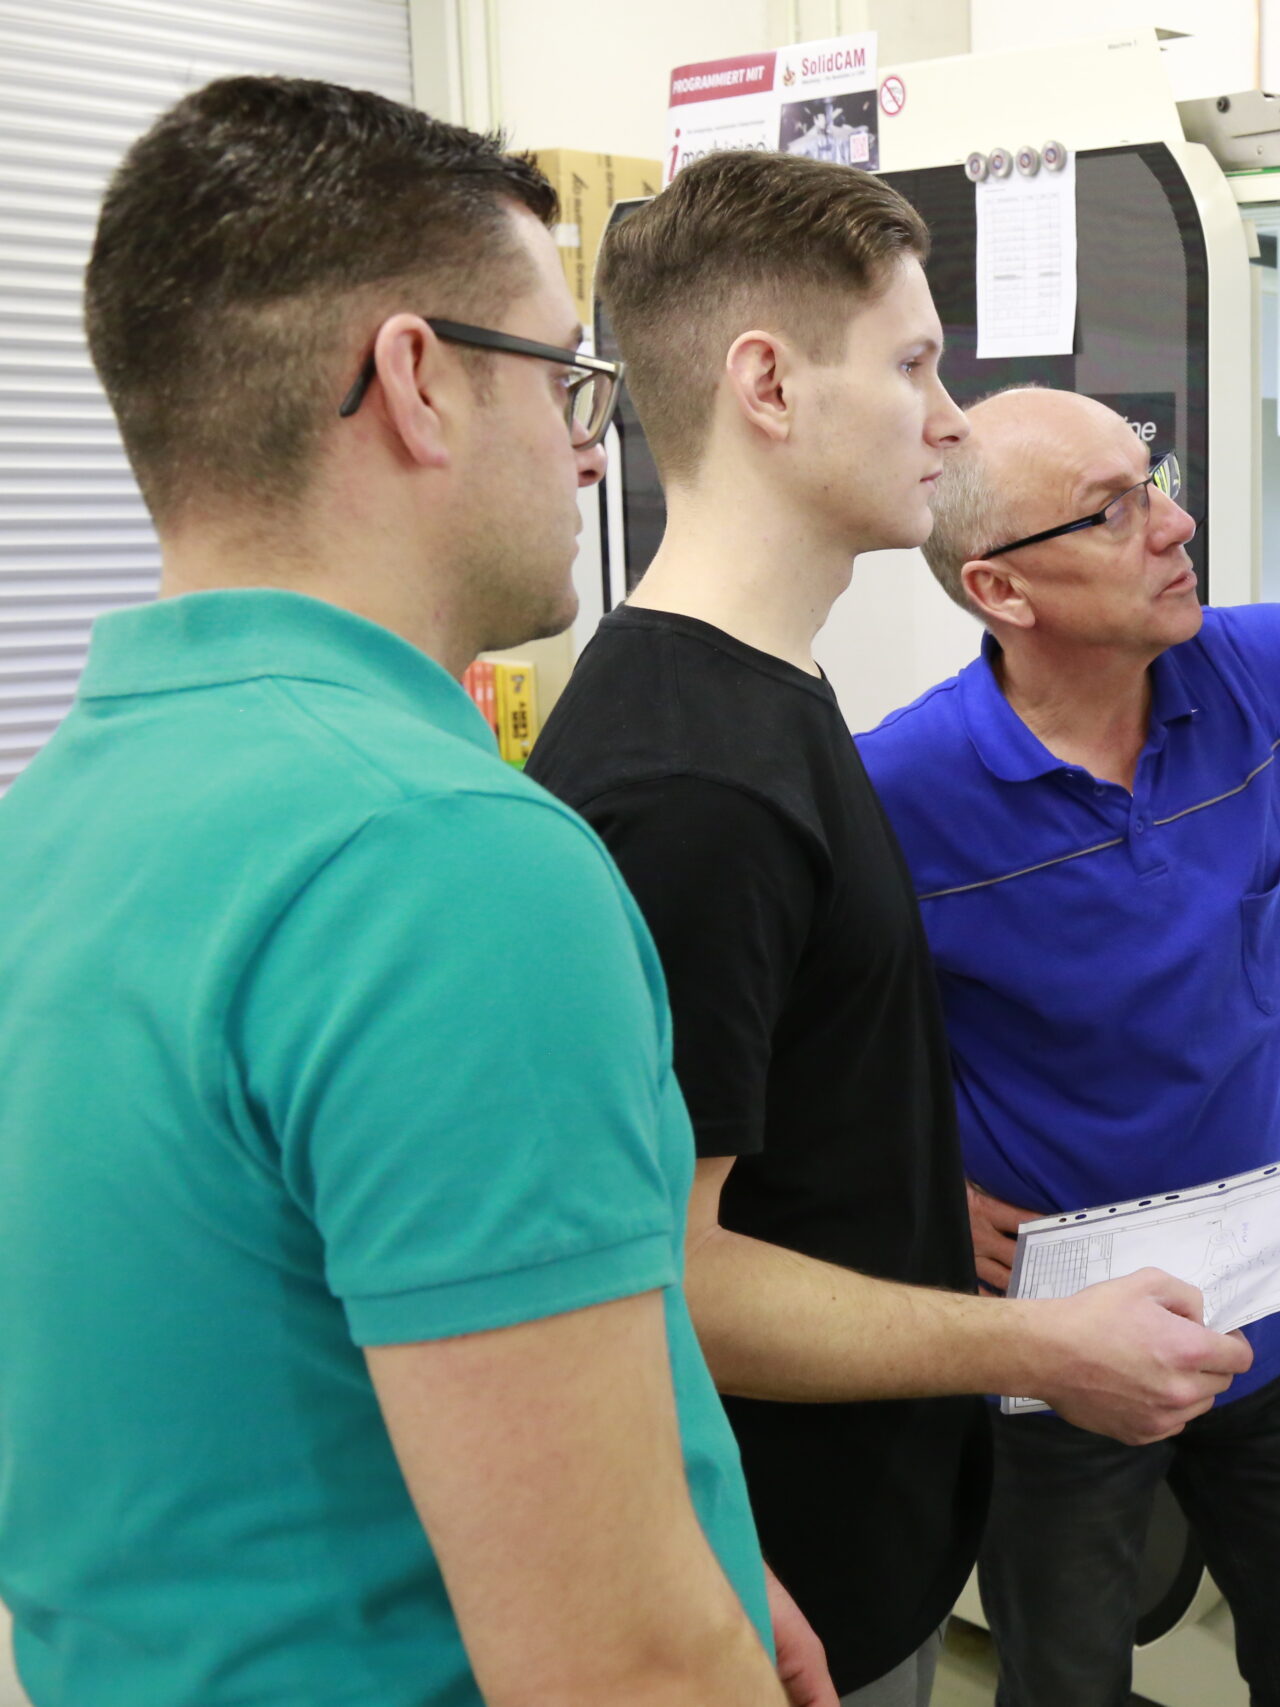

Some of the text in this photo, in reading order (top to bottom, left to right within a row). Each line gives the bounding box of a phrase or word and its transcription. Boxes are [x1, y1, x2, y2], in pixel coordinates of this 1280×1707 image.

[801, 47, 865, 76] SolidCAM
[672, 65, 765, 95] PROGRAMMIERT MIT
